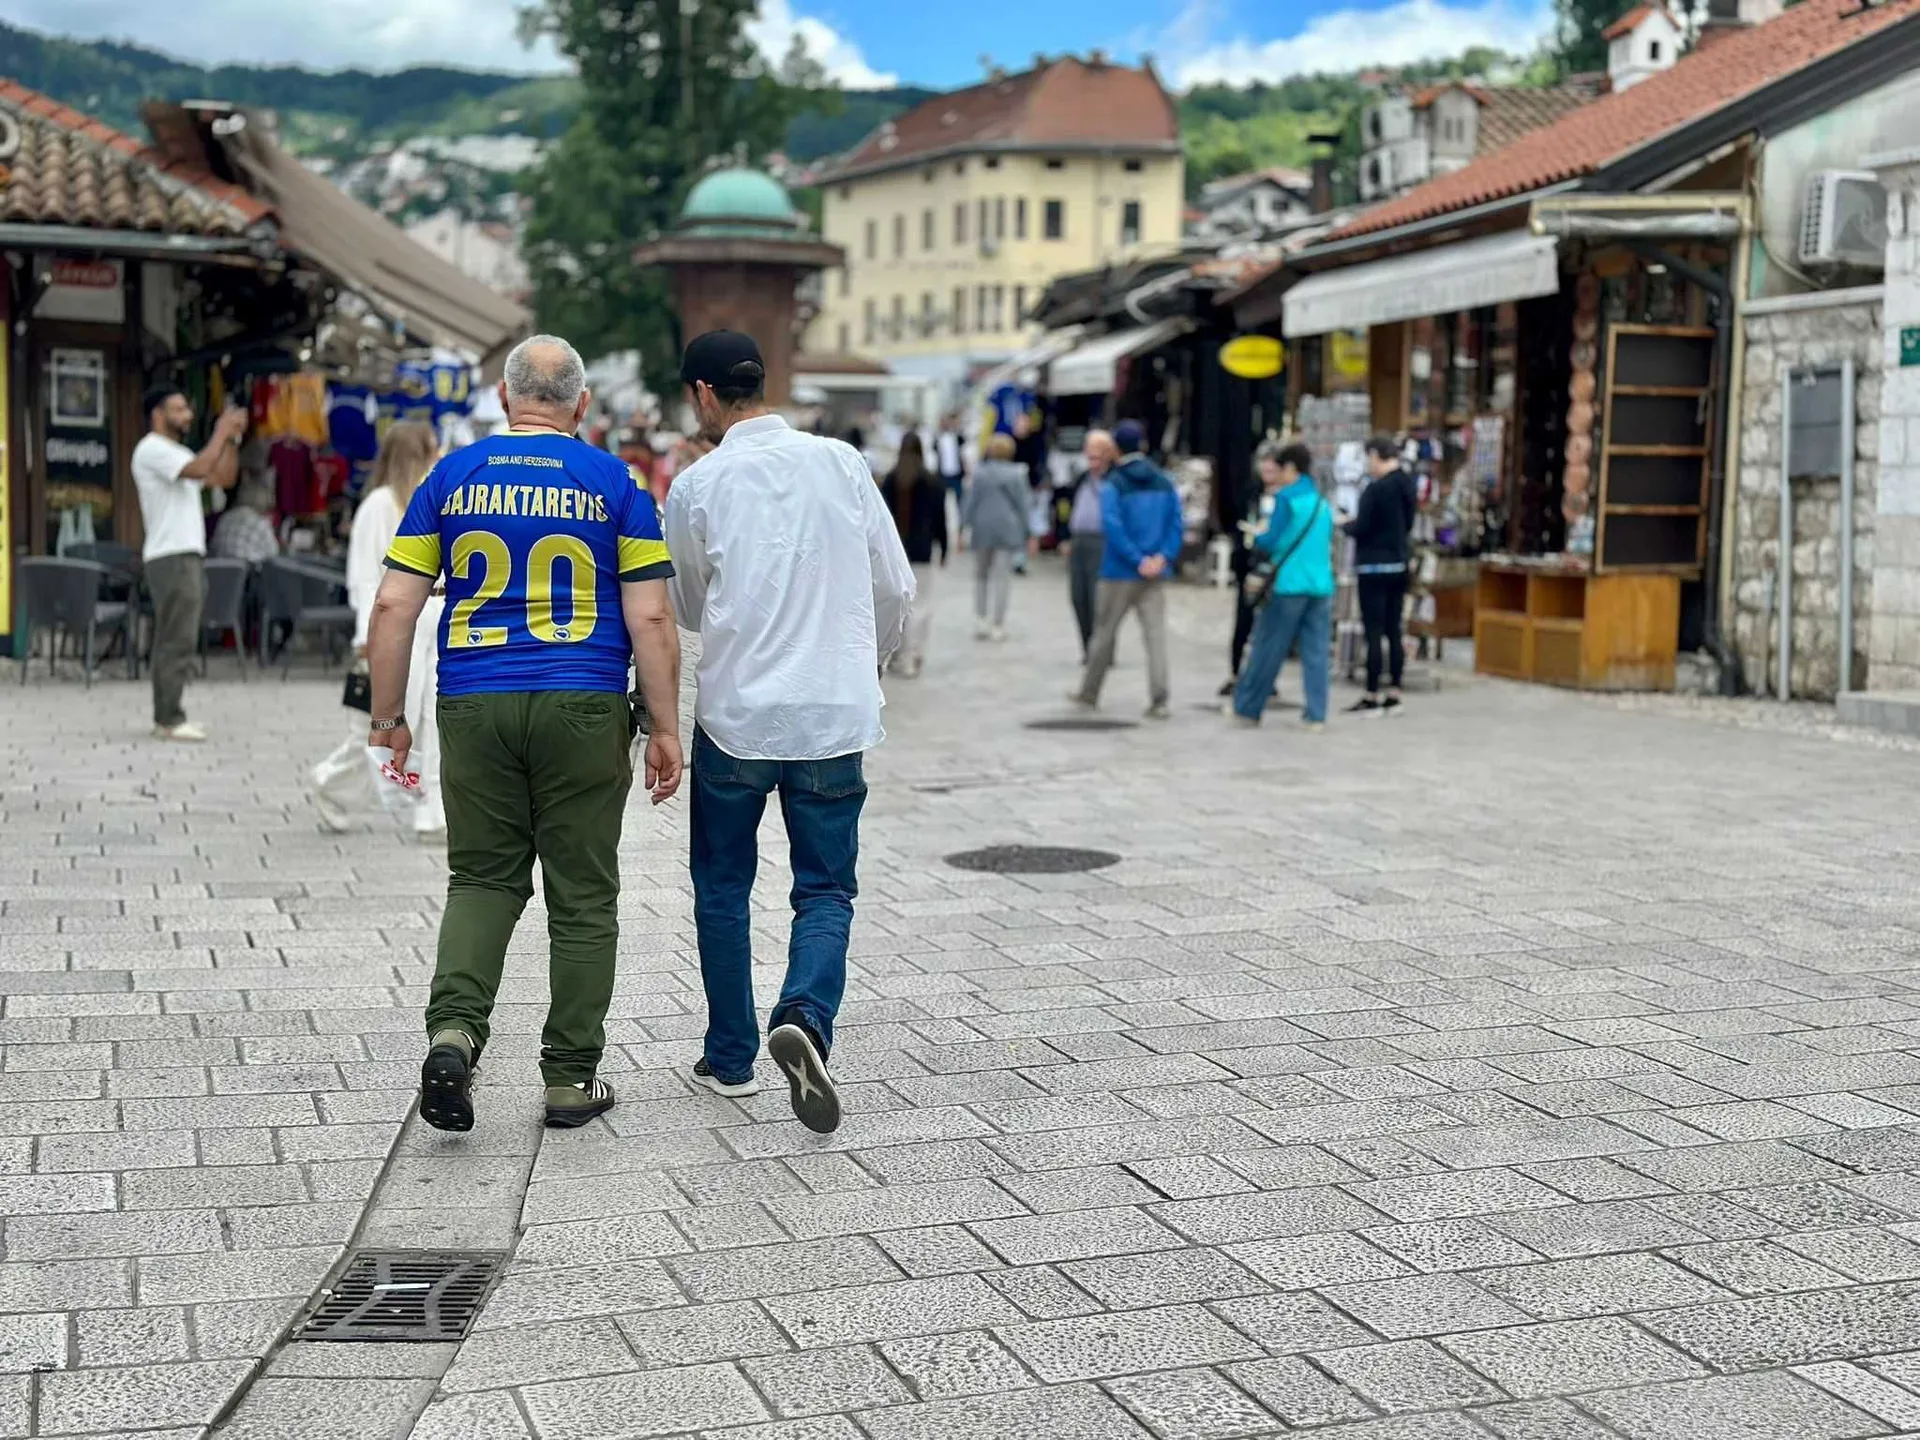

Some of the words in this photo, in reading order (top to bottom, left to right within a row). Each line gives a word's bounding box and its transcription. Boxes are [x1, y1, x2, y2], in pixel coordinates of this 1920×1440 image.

[487, 455, 509, 466] BOSNIA
[509, 455, 522, 465] AND
[523, 455, 564, 469] HERZEGOVINA
[447, 530, 597, 649] 20
